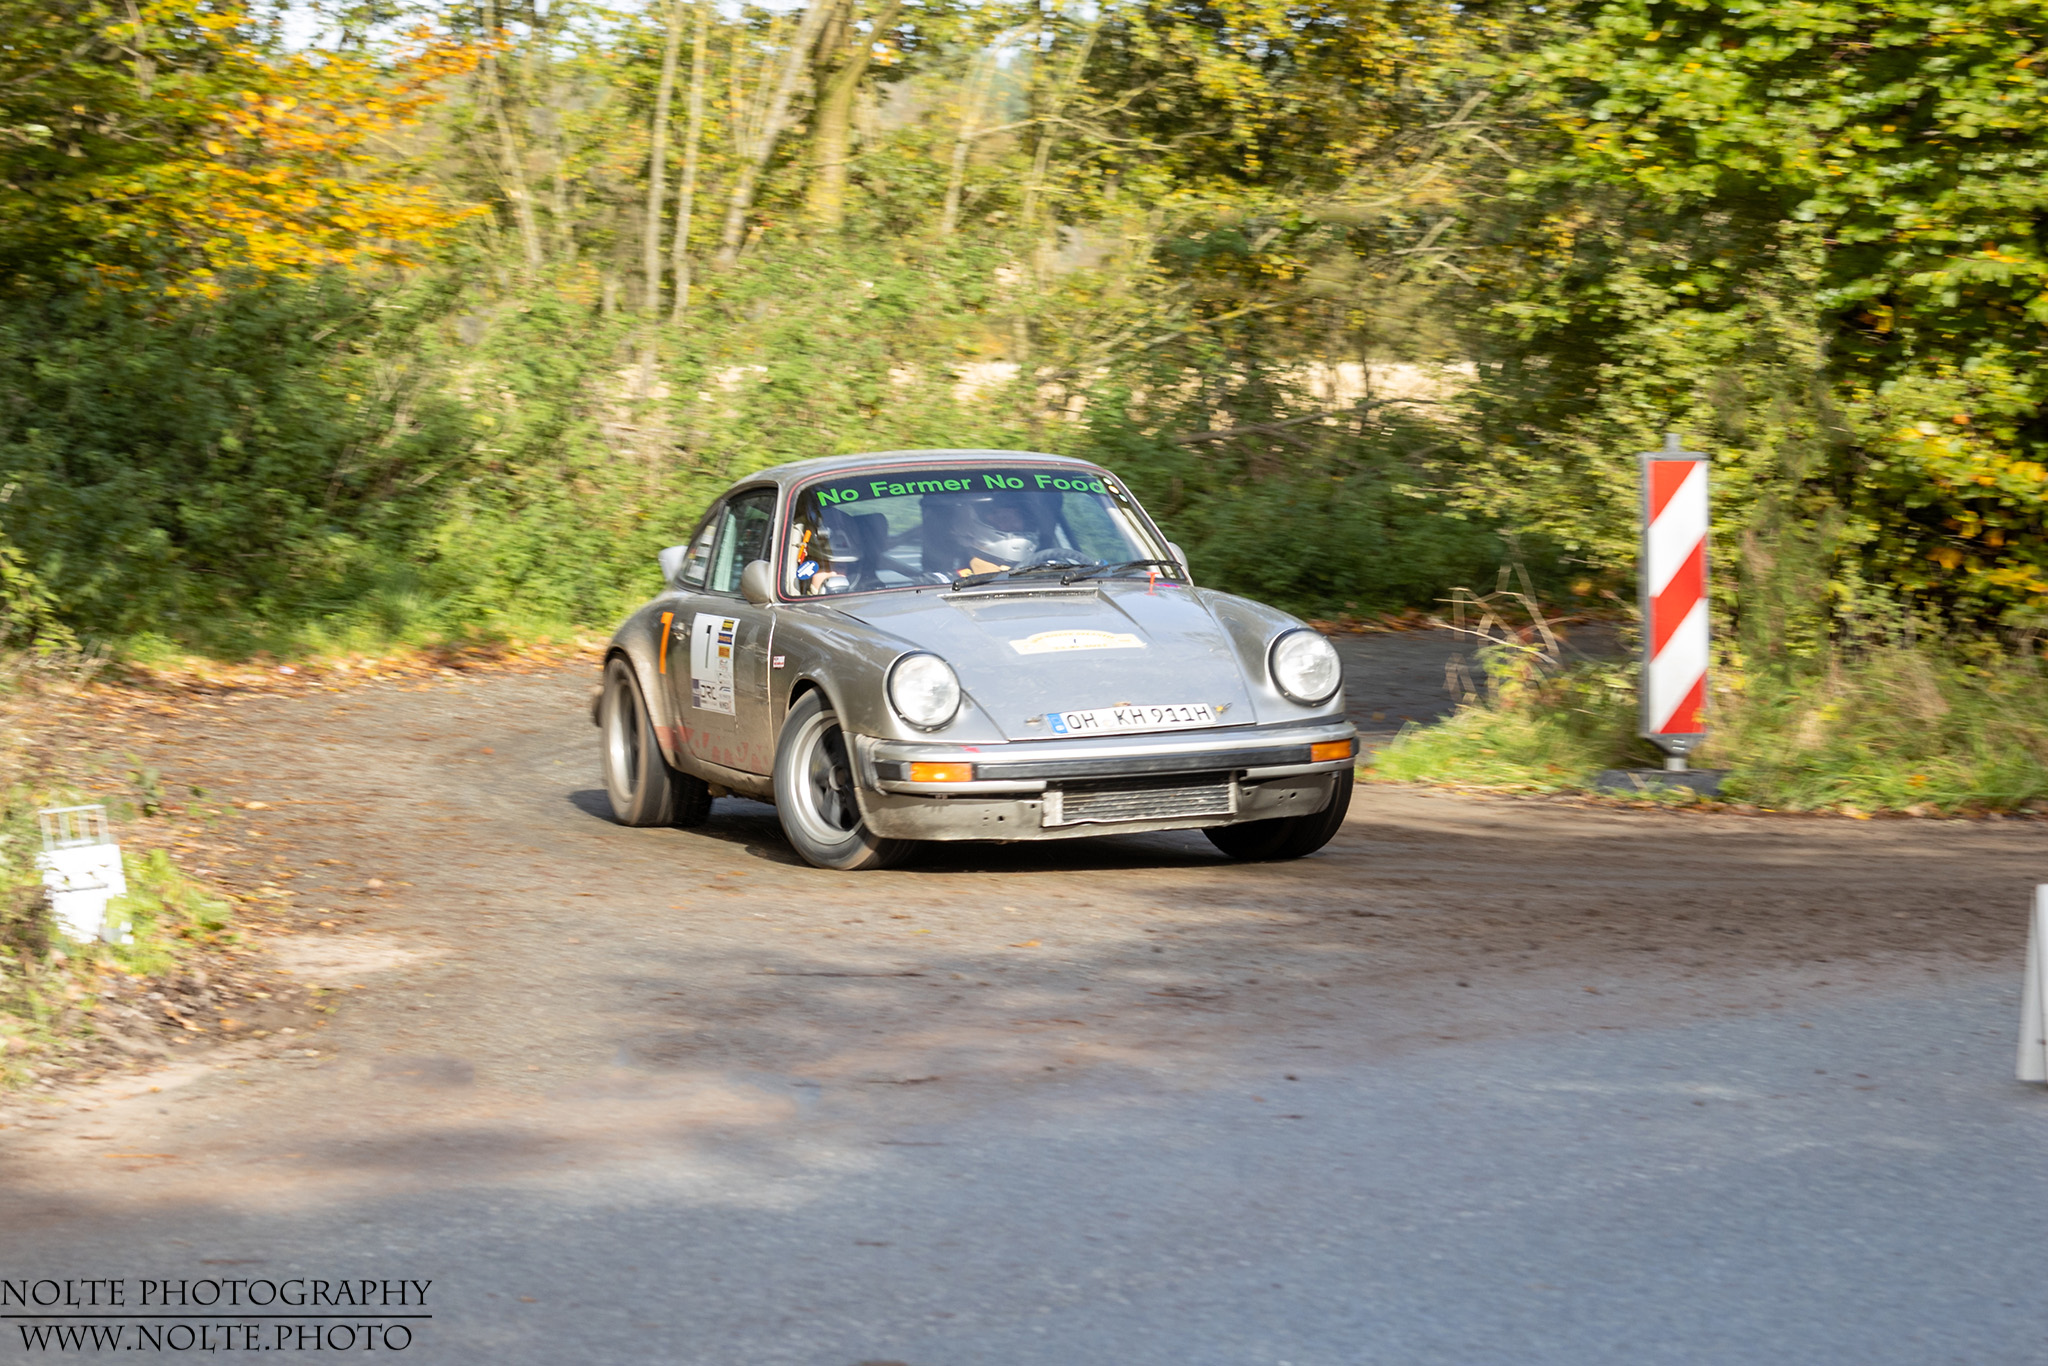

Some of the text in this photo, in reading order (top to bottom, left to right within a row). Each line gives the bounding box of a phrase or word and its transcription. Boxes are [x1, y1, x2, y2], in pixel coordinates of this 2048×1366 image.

[816, 474, 1106, 507] No Farmer No Food
[1066, 705, 1212, 730] OH KH 911H
